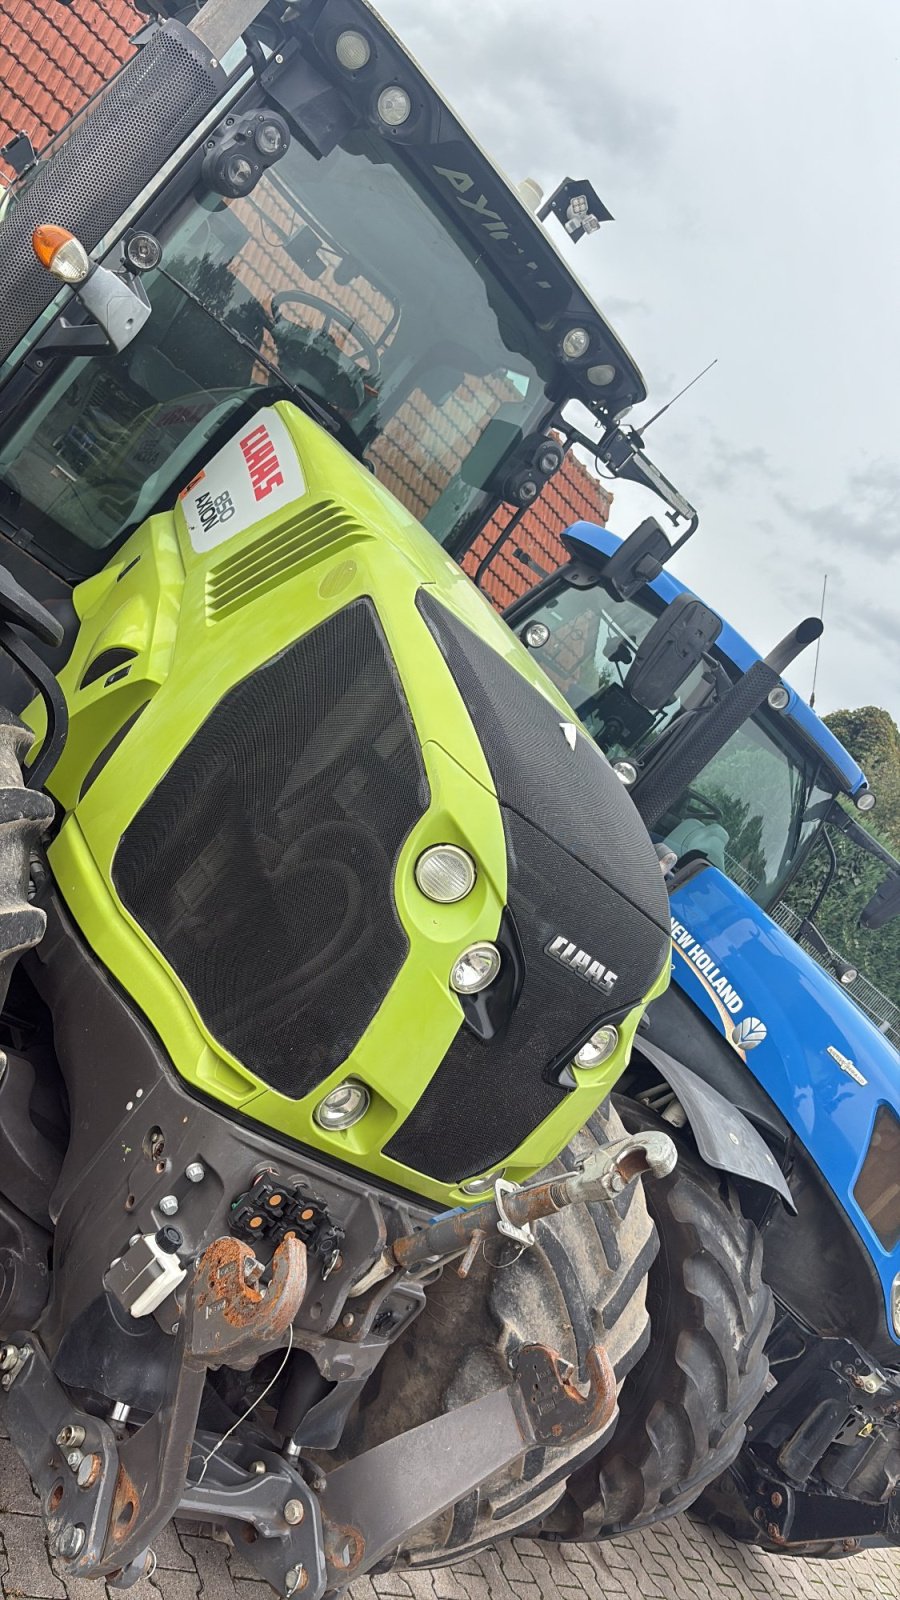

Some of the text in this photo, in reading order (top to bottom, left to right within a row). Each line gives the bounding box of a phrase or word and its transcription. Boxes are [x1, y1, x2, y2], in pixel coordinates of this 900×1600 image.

[239, 424, 284, 502] CLAAS
[194, 491, 220, 533] AXION
[213, 490, 236, 524] 850
[547, 935, 619, 993] CLAAS
[687, 943, 744, 1014] HOLLAND
